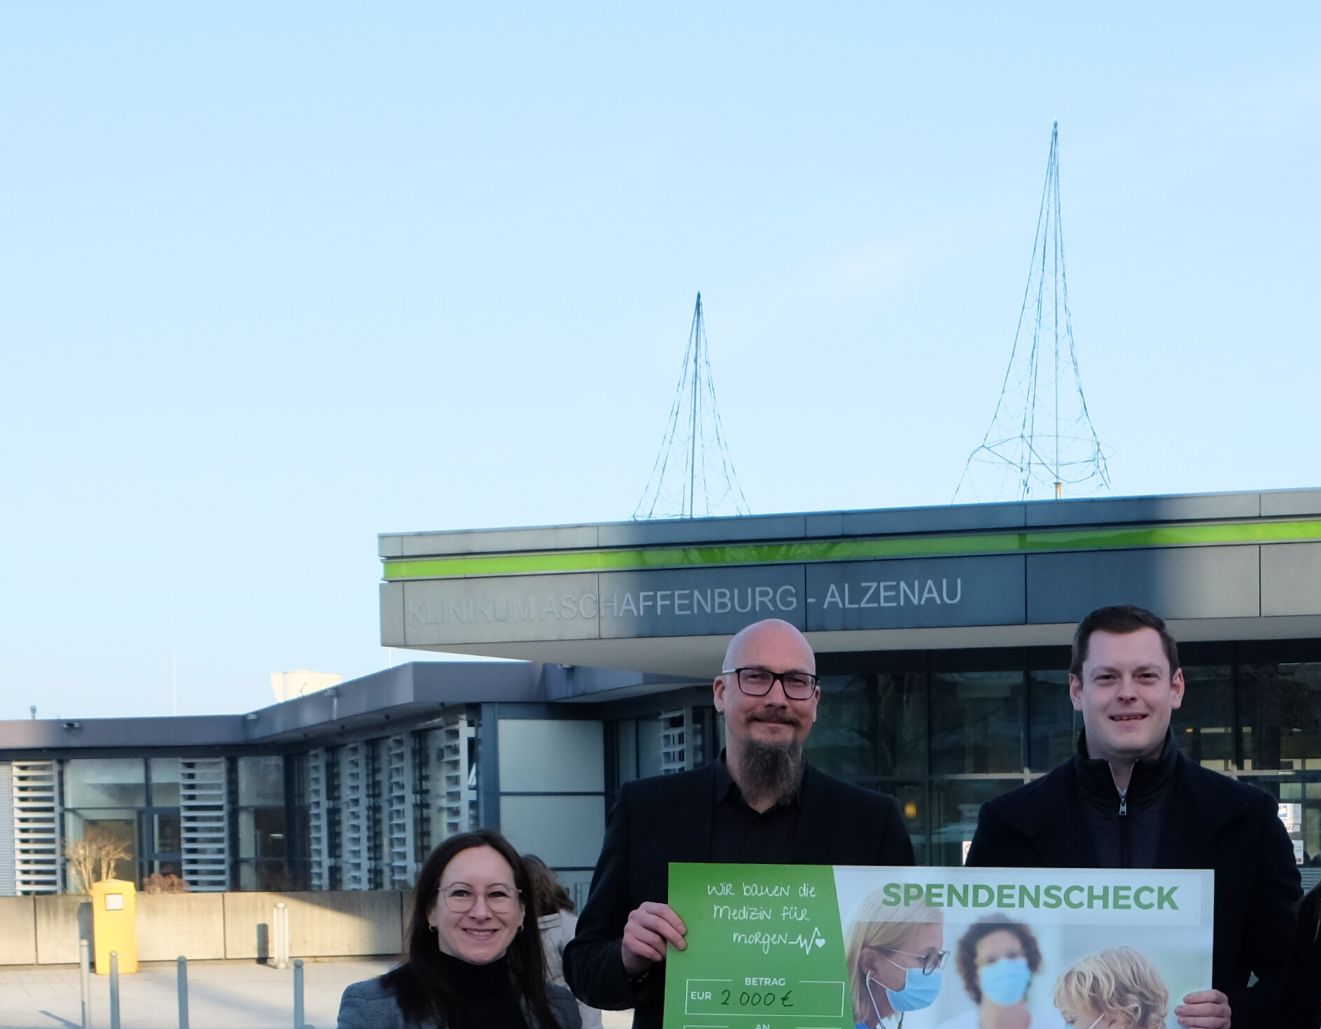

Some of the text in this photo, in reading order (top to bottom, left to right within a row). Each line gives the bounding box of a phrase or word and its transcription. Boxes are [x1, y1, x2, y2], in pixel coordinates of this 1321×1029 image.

[408, 594, 535, 625] KLINIKUM
[542, 585, 797, 620] ASCHAFFENBURG
[823, 578, 962, 609] ALZENAU
[743, 882, 790, 897] bauen
[798, 883, 816, 897] die
[881, 883, 1180, 910] SPENDENSCHECK
[781, 905, 810, 921] für
[744, 977, 786, 986] BETRAG
[690, 991, 712, 1000] EUR
